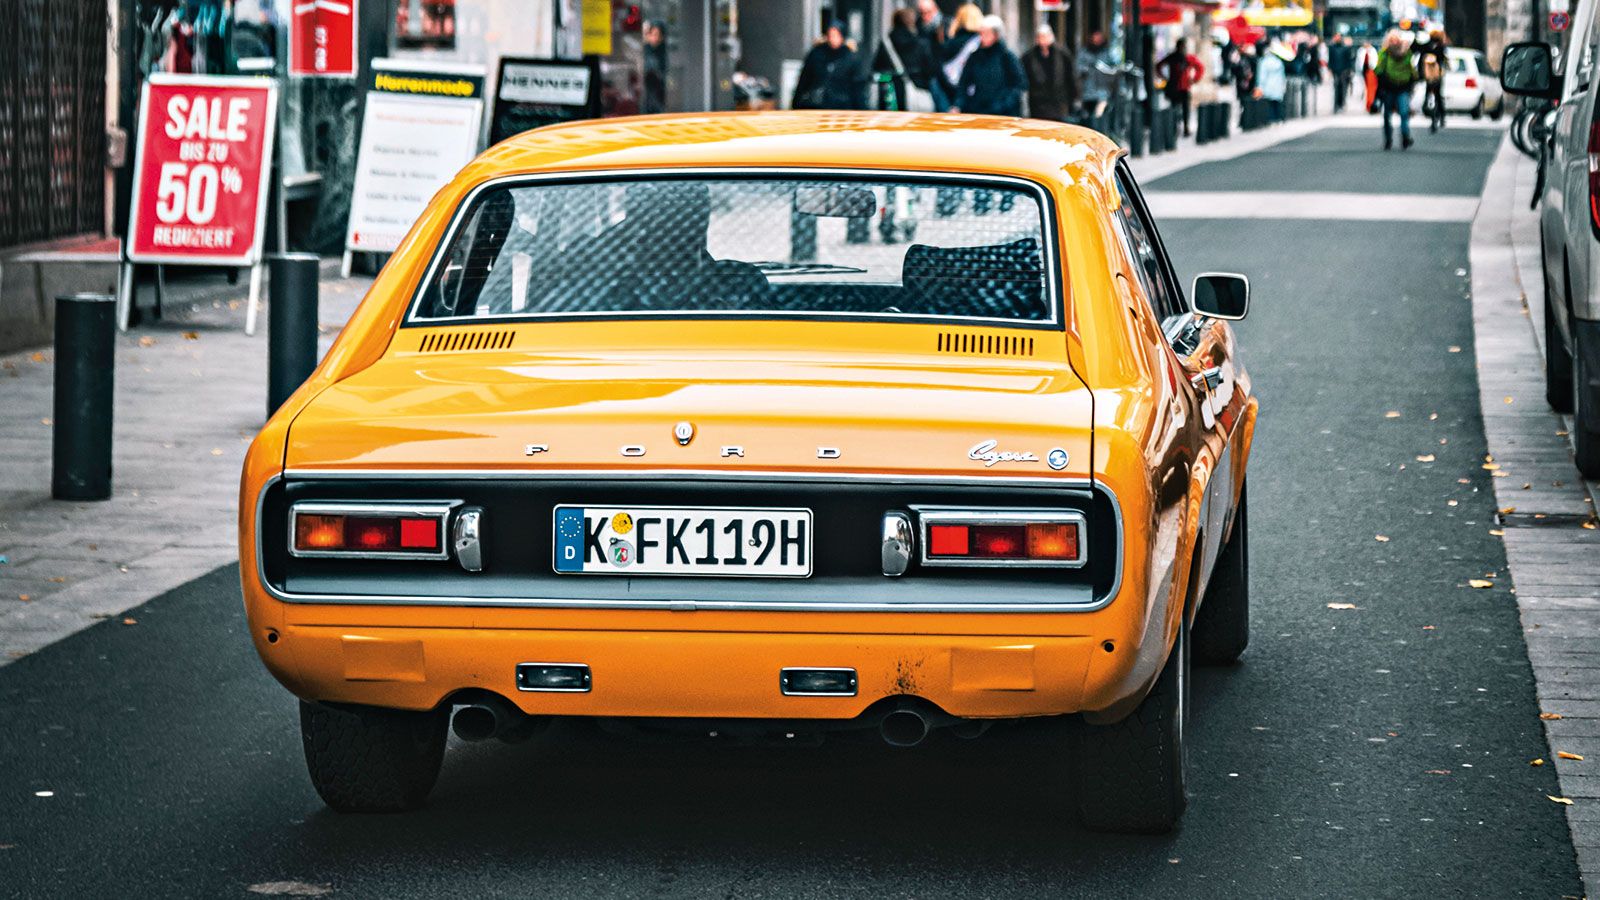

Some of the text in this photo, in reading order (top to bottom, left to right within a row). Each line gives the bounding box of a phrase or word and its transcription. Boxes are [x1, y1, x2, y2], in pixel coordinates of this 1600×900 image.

[375, 74, 475, 97] Herrenmode
[164, 95, 251, 142] SALE
[179, 142, 229, 162] BIS ZU
[153, 225, 234, 248] REDUZIERT
[525, 443, 842, 459] FORD
[564, 545, 576, 560] D
